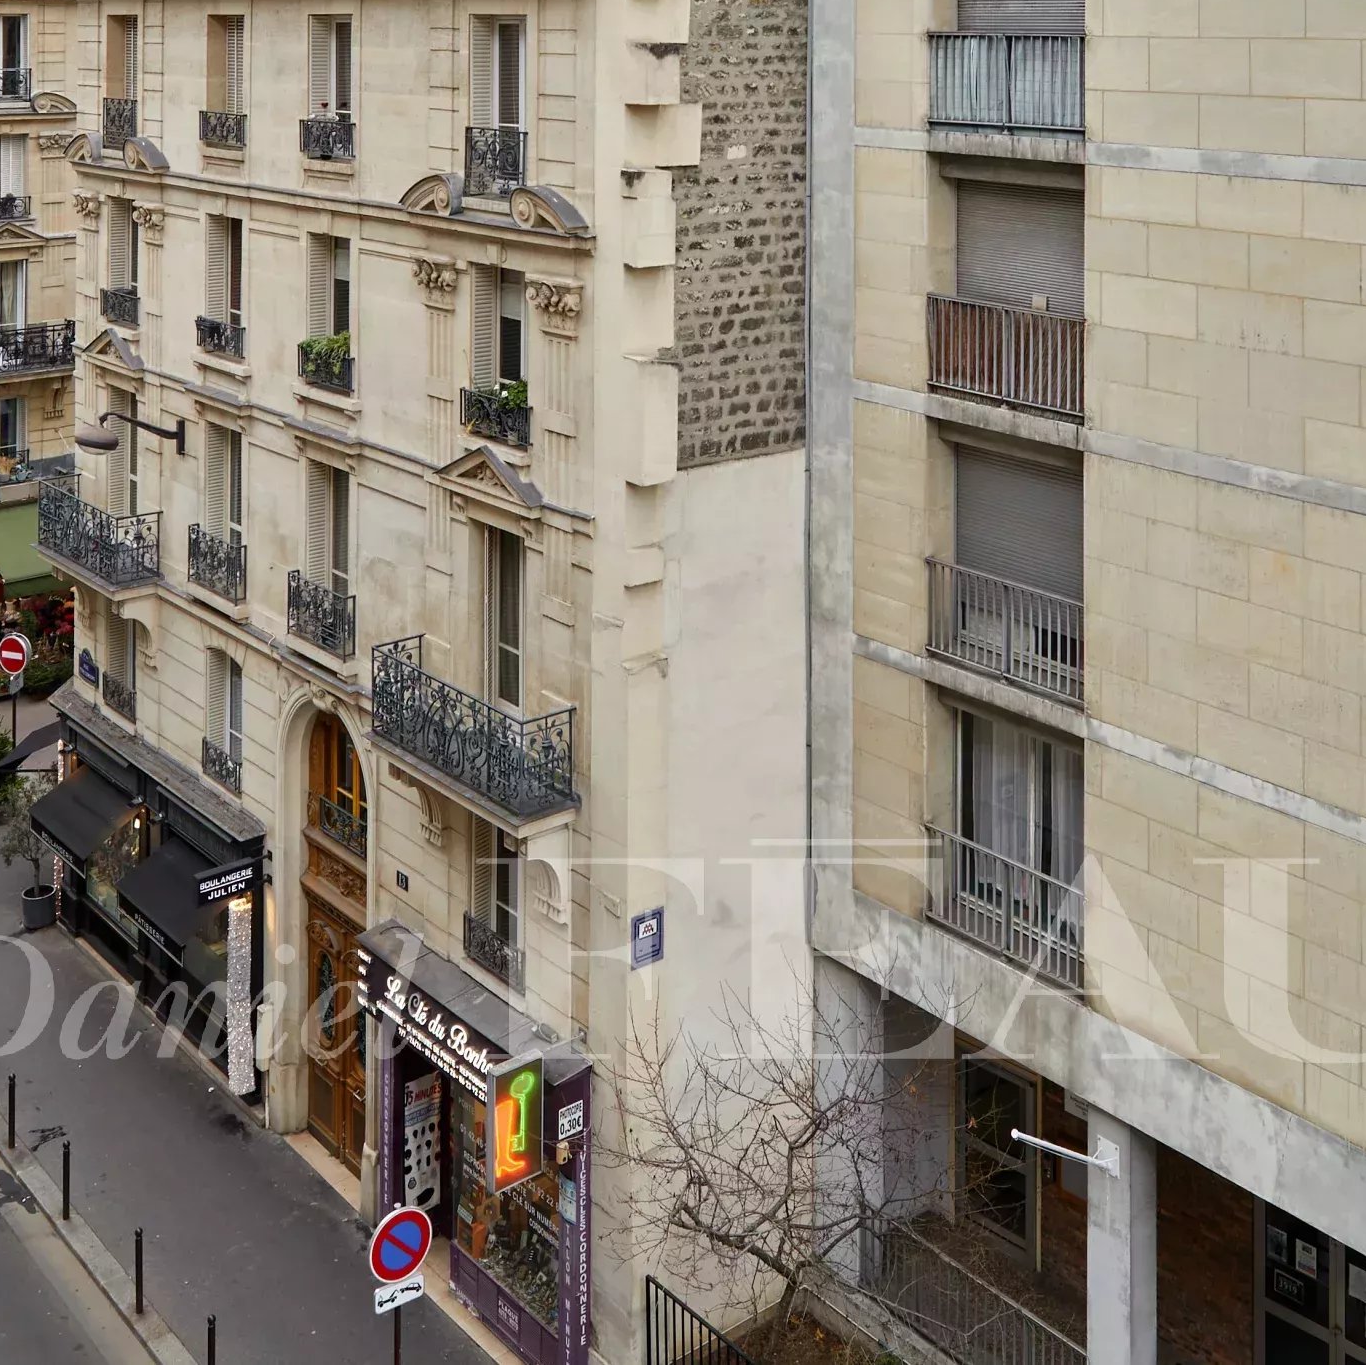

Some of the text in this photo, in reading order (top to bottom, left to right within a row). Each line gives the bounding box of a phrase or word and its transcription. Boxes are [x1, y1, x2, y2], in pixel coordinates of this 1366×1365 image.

[199, 866, 253, 891] BOULANGERIE
[207, 881, 246, 900] JULIEN
[384, 976, 406, 1010] La
[407, 993, 428, 1025] Clé
[427, 1014, 446, 1041] du
[559, 1102, 582, 1120] PHOTOCOPIE
[579, 1232, 587, 1346] CORDONNERIE
